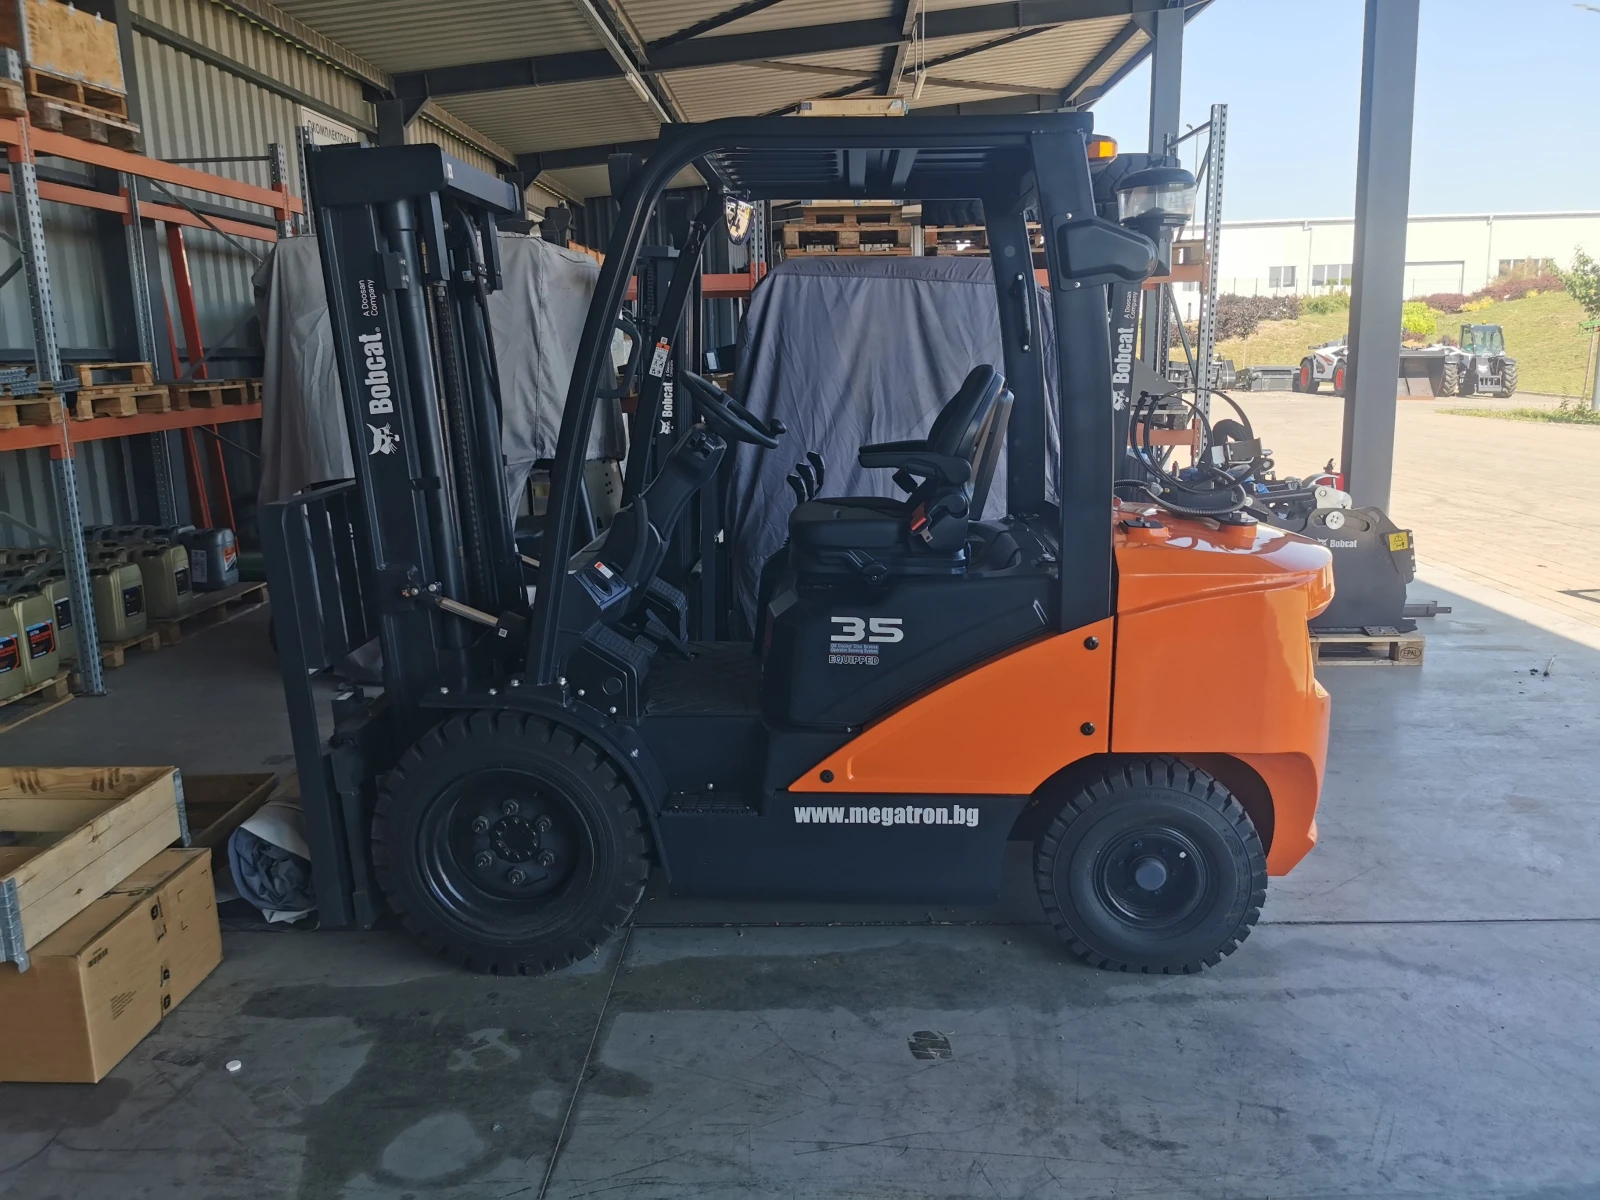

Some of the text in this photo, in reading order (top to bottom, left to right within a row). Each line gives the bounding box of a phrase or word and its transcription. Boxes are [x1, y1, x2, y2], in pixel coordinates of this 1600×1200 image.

[359, 280, 369, 309] Doosan
[367, 280, 379, 316] Company
[1130, 291, 1138, 319] Company
[1112, 327, 1134, 383] Bobcat
[358, 332, 394, 415] Bobcat
[662, 382, 673, 417] Bobcat
[1329, 539, 1357, 548] Bobcat
[830, 616, 904, 643] 35
[828, 654, 880, 666] EQUIPPED
[794, 804, 979, 827] www.megatron.bg
